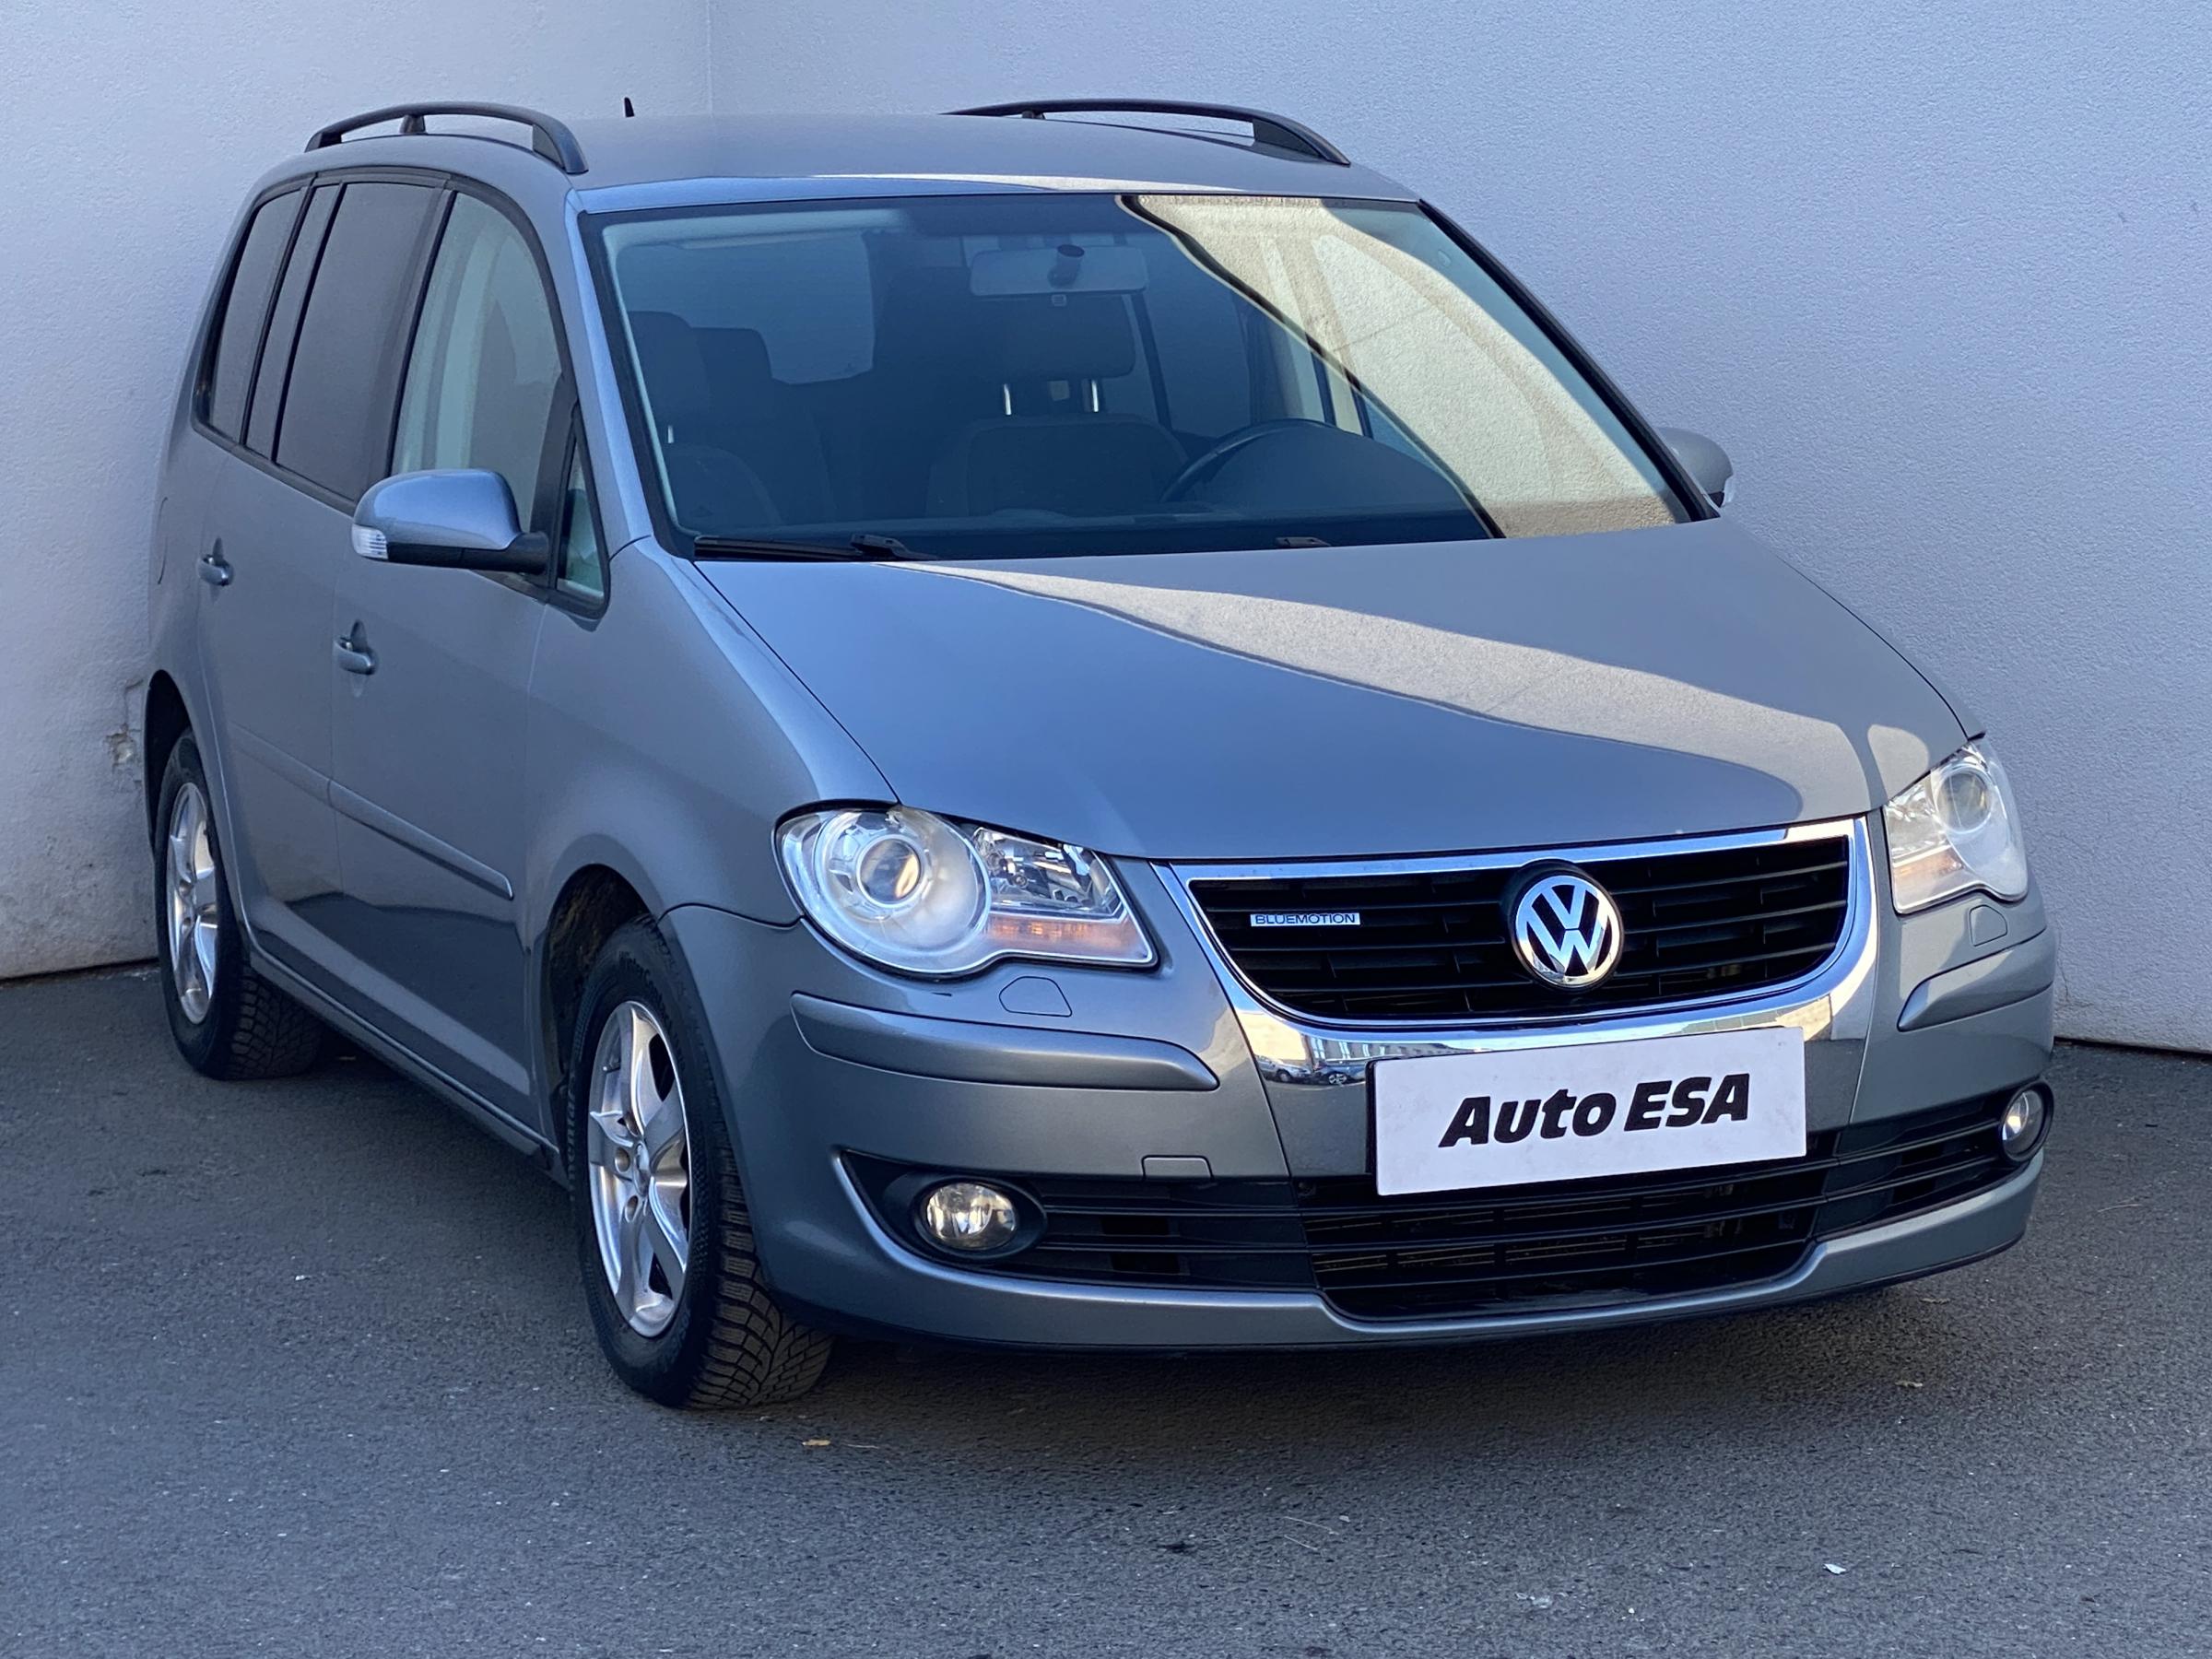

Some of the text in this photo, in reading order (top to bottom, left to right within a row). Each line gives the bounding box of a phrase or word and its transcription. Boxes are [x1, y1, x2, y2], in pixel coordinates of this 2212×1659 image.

[1254, 913, 1356, 924] BLUEMOTION
[1517, 877, 1619, 986] VW
[1438, 1073, 1750, 1147] Auto ESA
